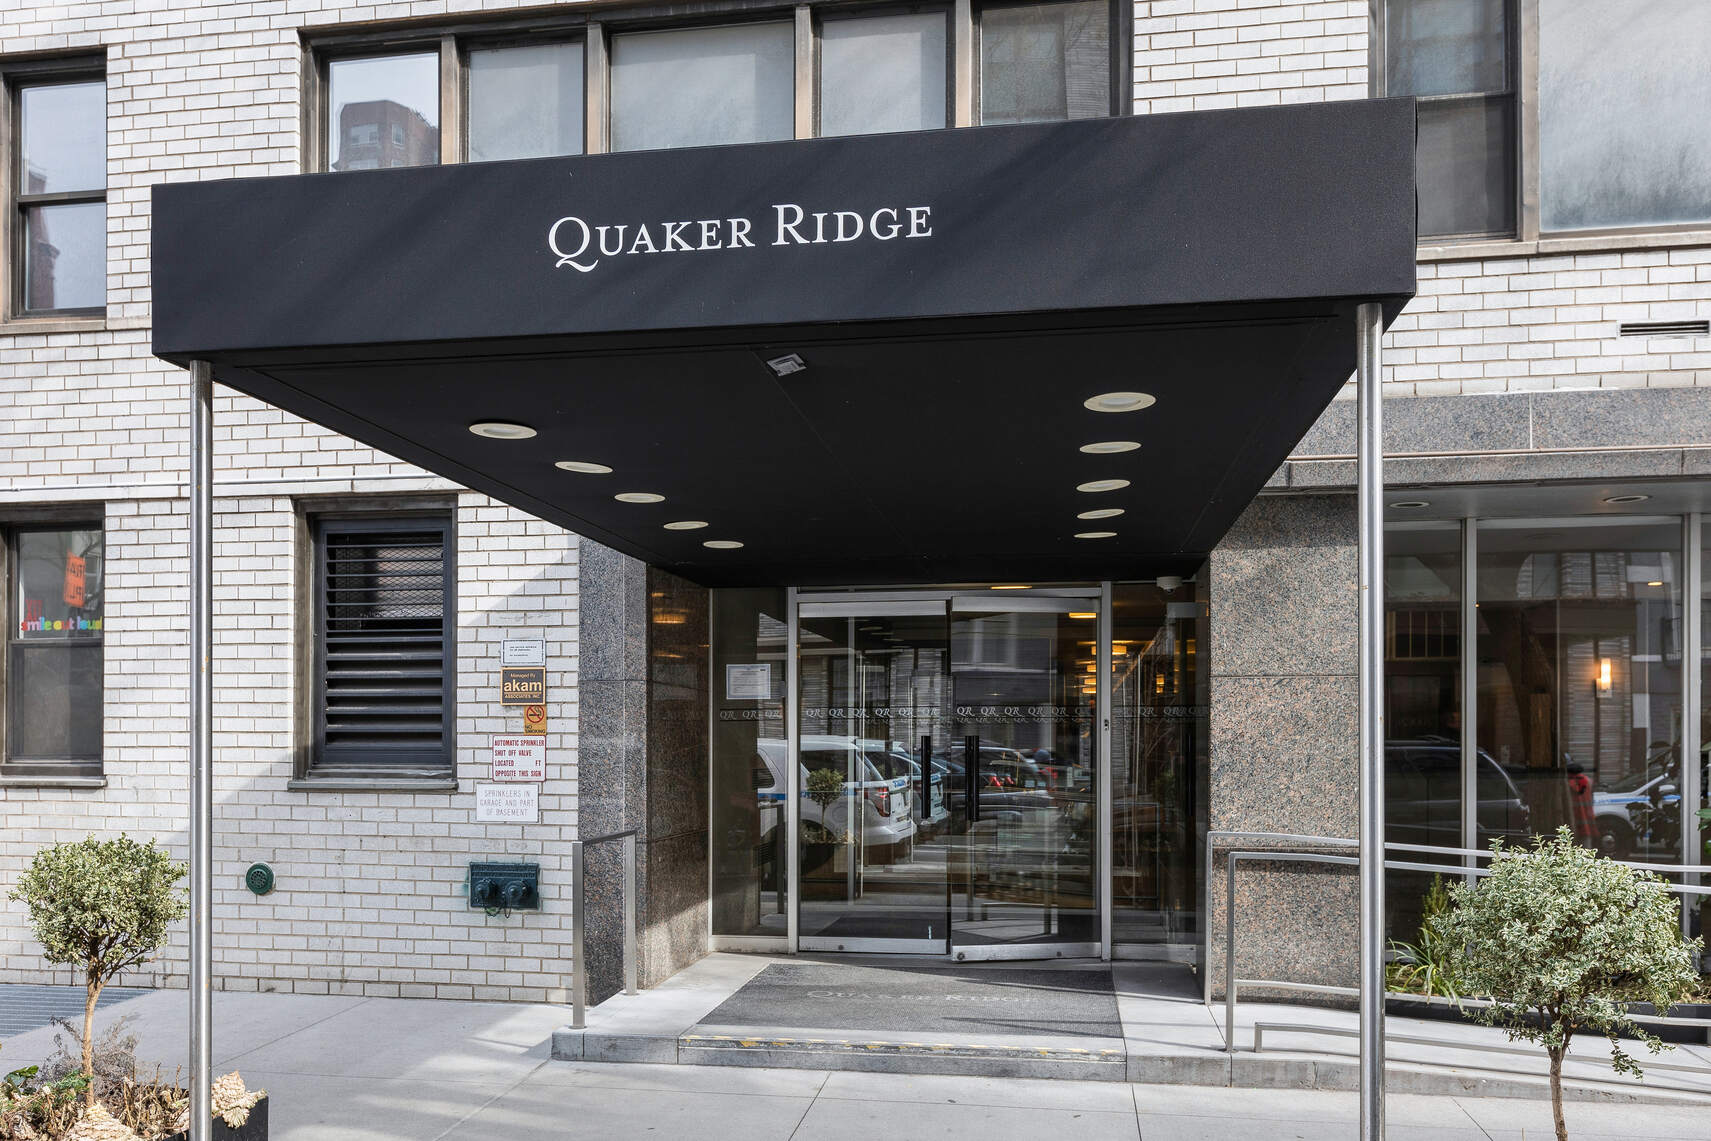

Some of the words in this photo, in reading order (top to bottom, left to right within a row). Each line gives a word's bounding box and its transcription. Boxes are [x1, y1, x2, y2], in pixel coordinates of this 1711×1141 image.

[548, 216, 755, 273] QUAKER
[771, 203, 933, 246] RIDGE
[21, 616, 52, 631] smile
[53, 617, 75, 630] out
[77, 616, 102, 630] loud
[504, 679, 542, 692] akam
[957, 706, 975, 717] QR
[981, 706, 999, 717] QR
[1004, 706, 1023, 717] QR
[520, 799, 534, 807] PART
